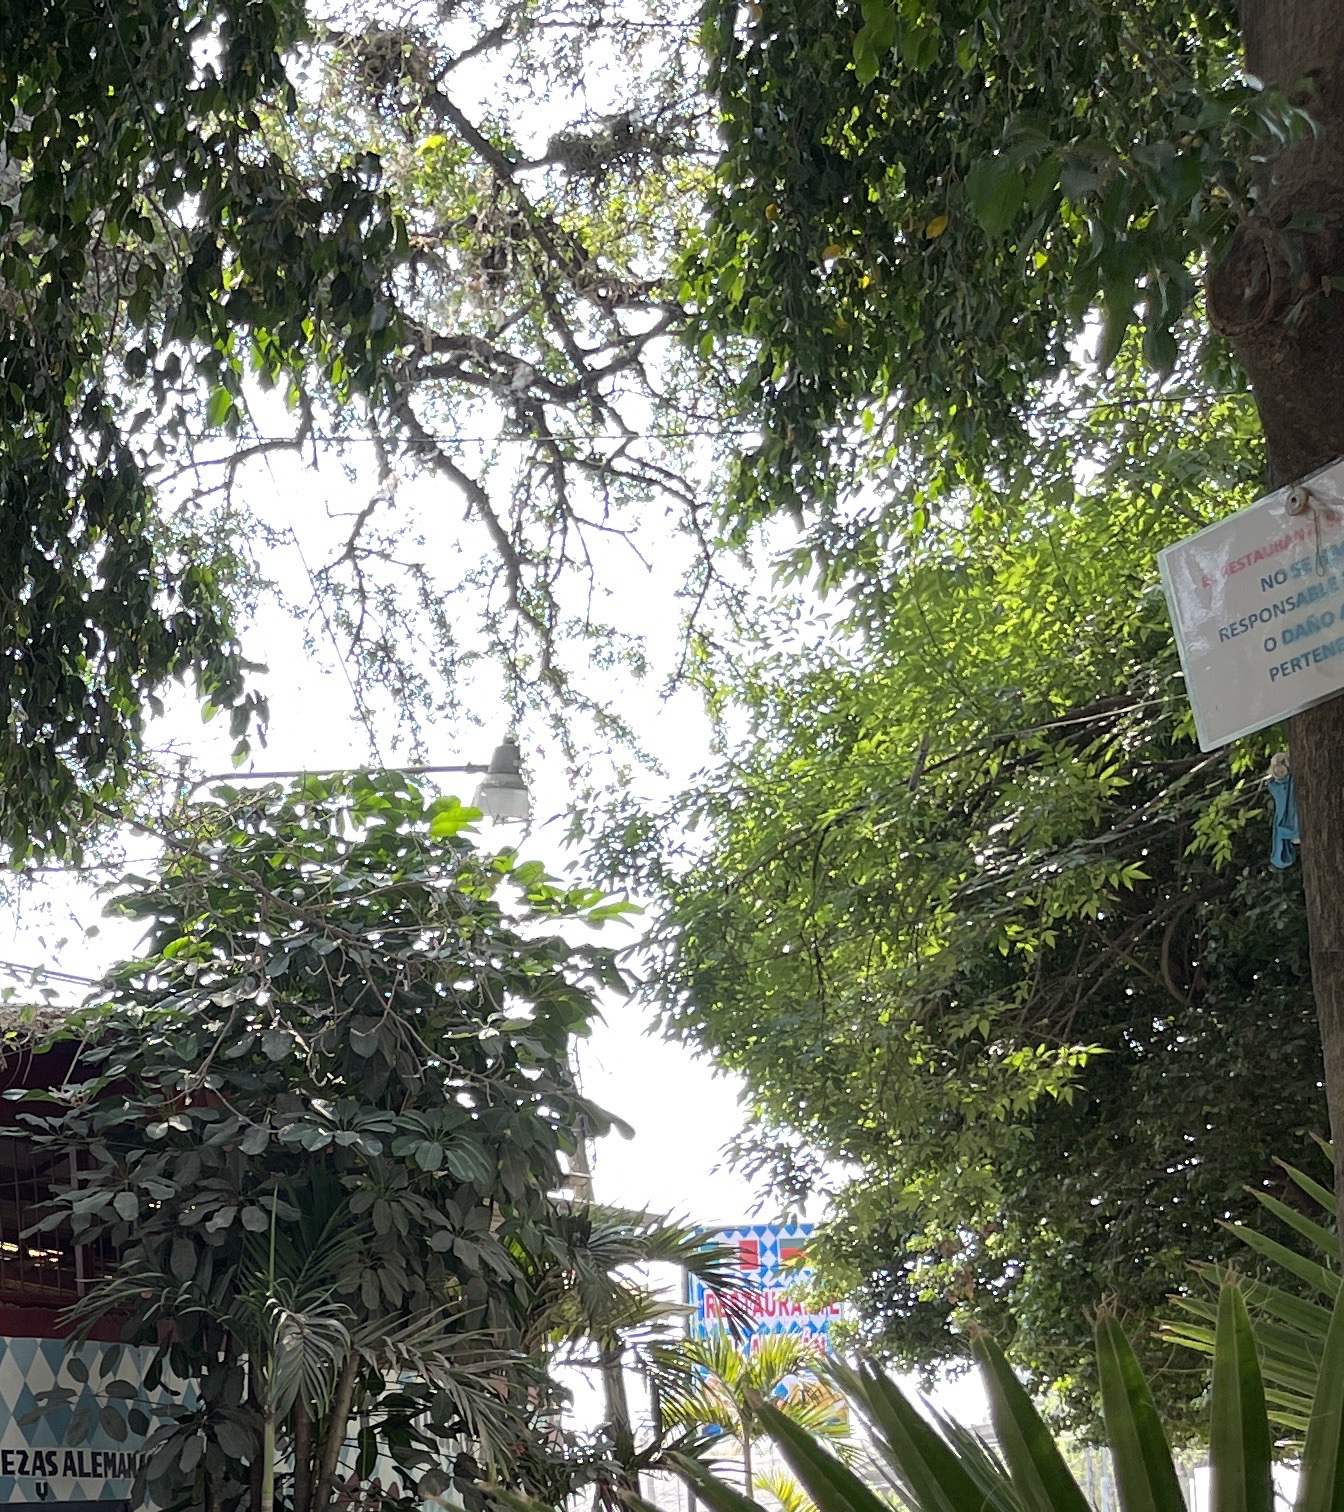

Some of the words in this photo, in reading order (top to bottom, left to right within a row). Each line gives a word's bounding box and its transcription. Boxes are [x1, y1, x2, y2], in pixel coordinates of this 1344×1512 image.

[1260, 568, 1288, 592] NO
[1218, 575, 1339, 642] RESPONSABLE
[1263, 637, 1277, 652] O
[1282, 611, 1335, 646] DAÑO
